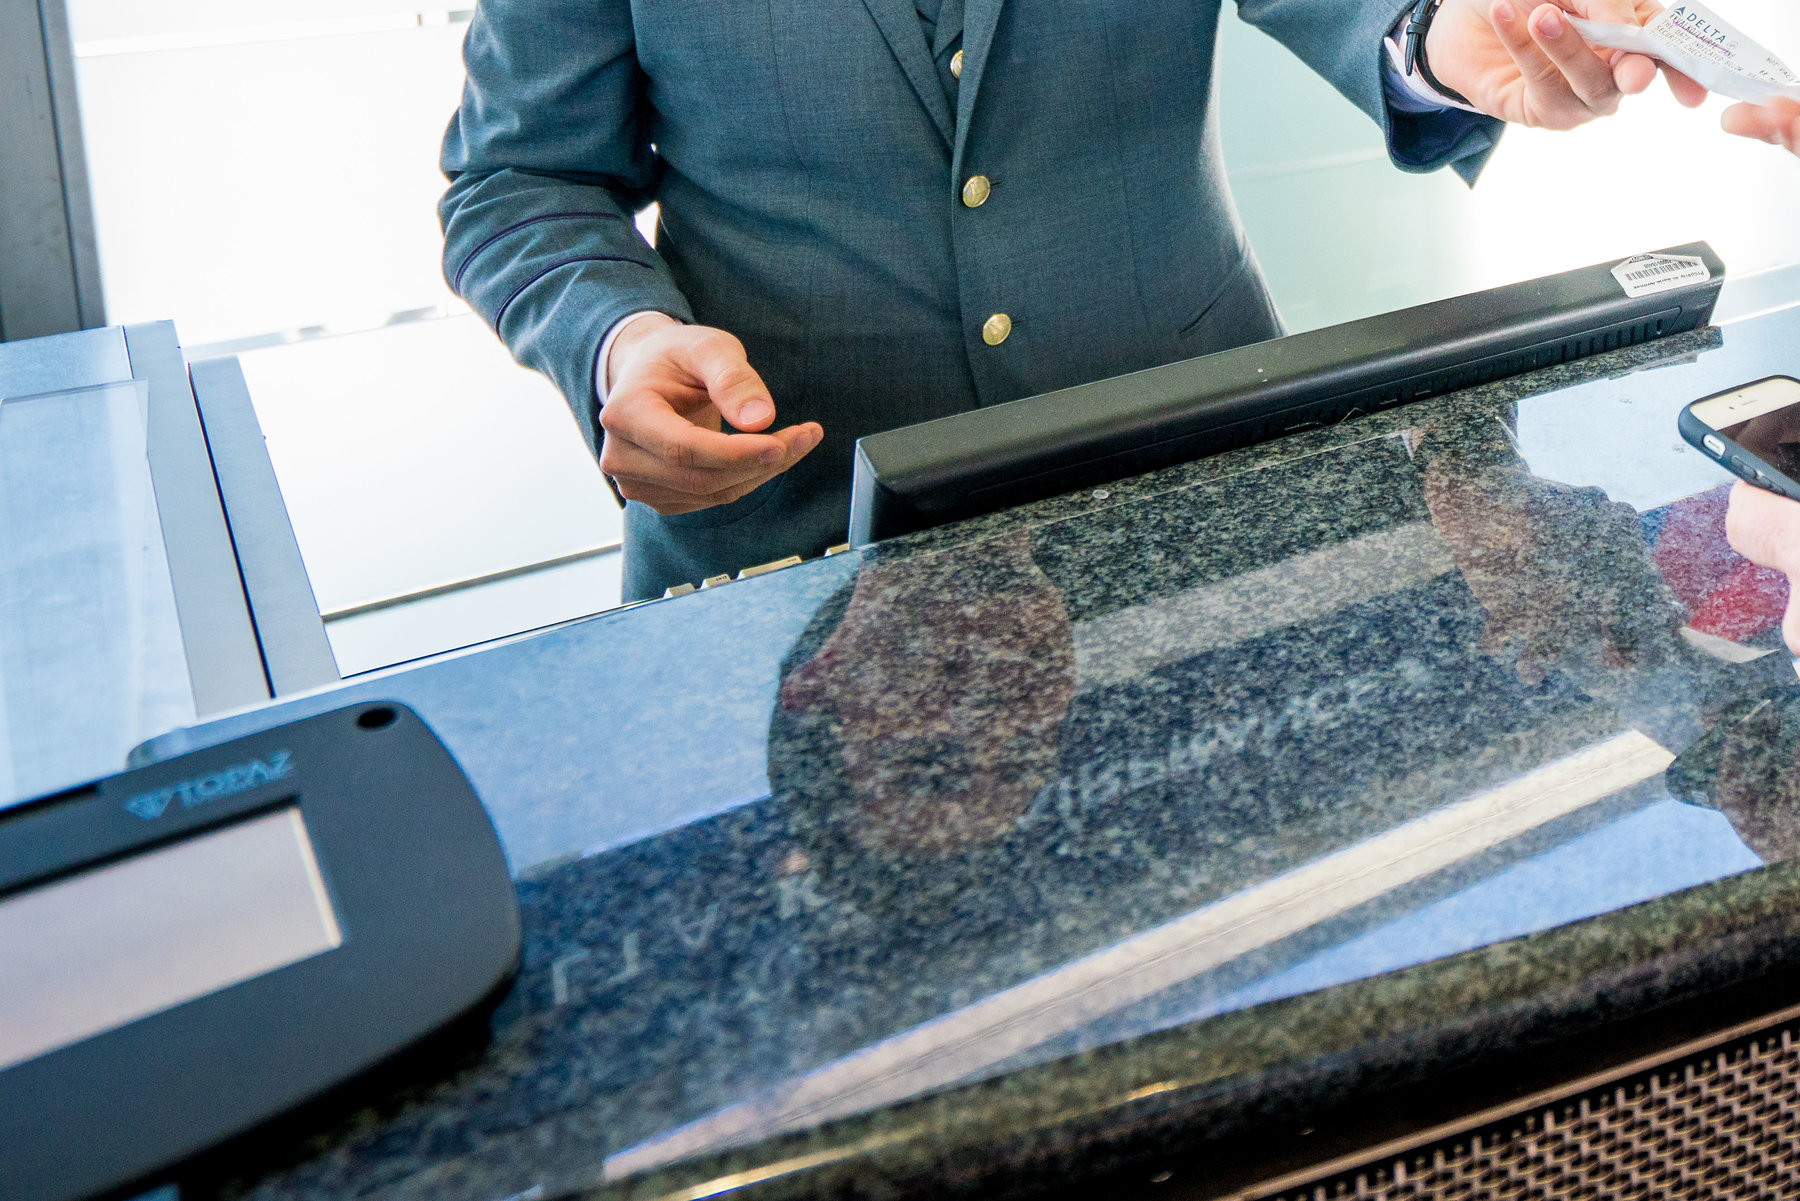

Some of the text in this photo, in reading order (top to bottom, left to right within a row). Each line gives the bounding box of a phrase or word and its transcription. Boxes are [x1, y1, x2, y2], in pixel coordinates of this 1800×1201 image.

[1655, 24, 1684, 44] SECURITY
[1662, 19, 1674, 30] THE
[1675, 29, 1691, 41] DATE
[1686, 12, 1727, 44] DELTA
[175, 750, 294, 810] TOPAZ
